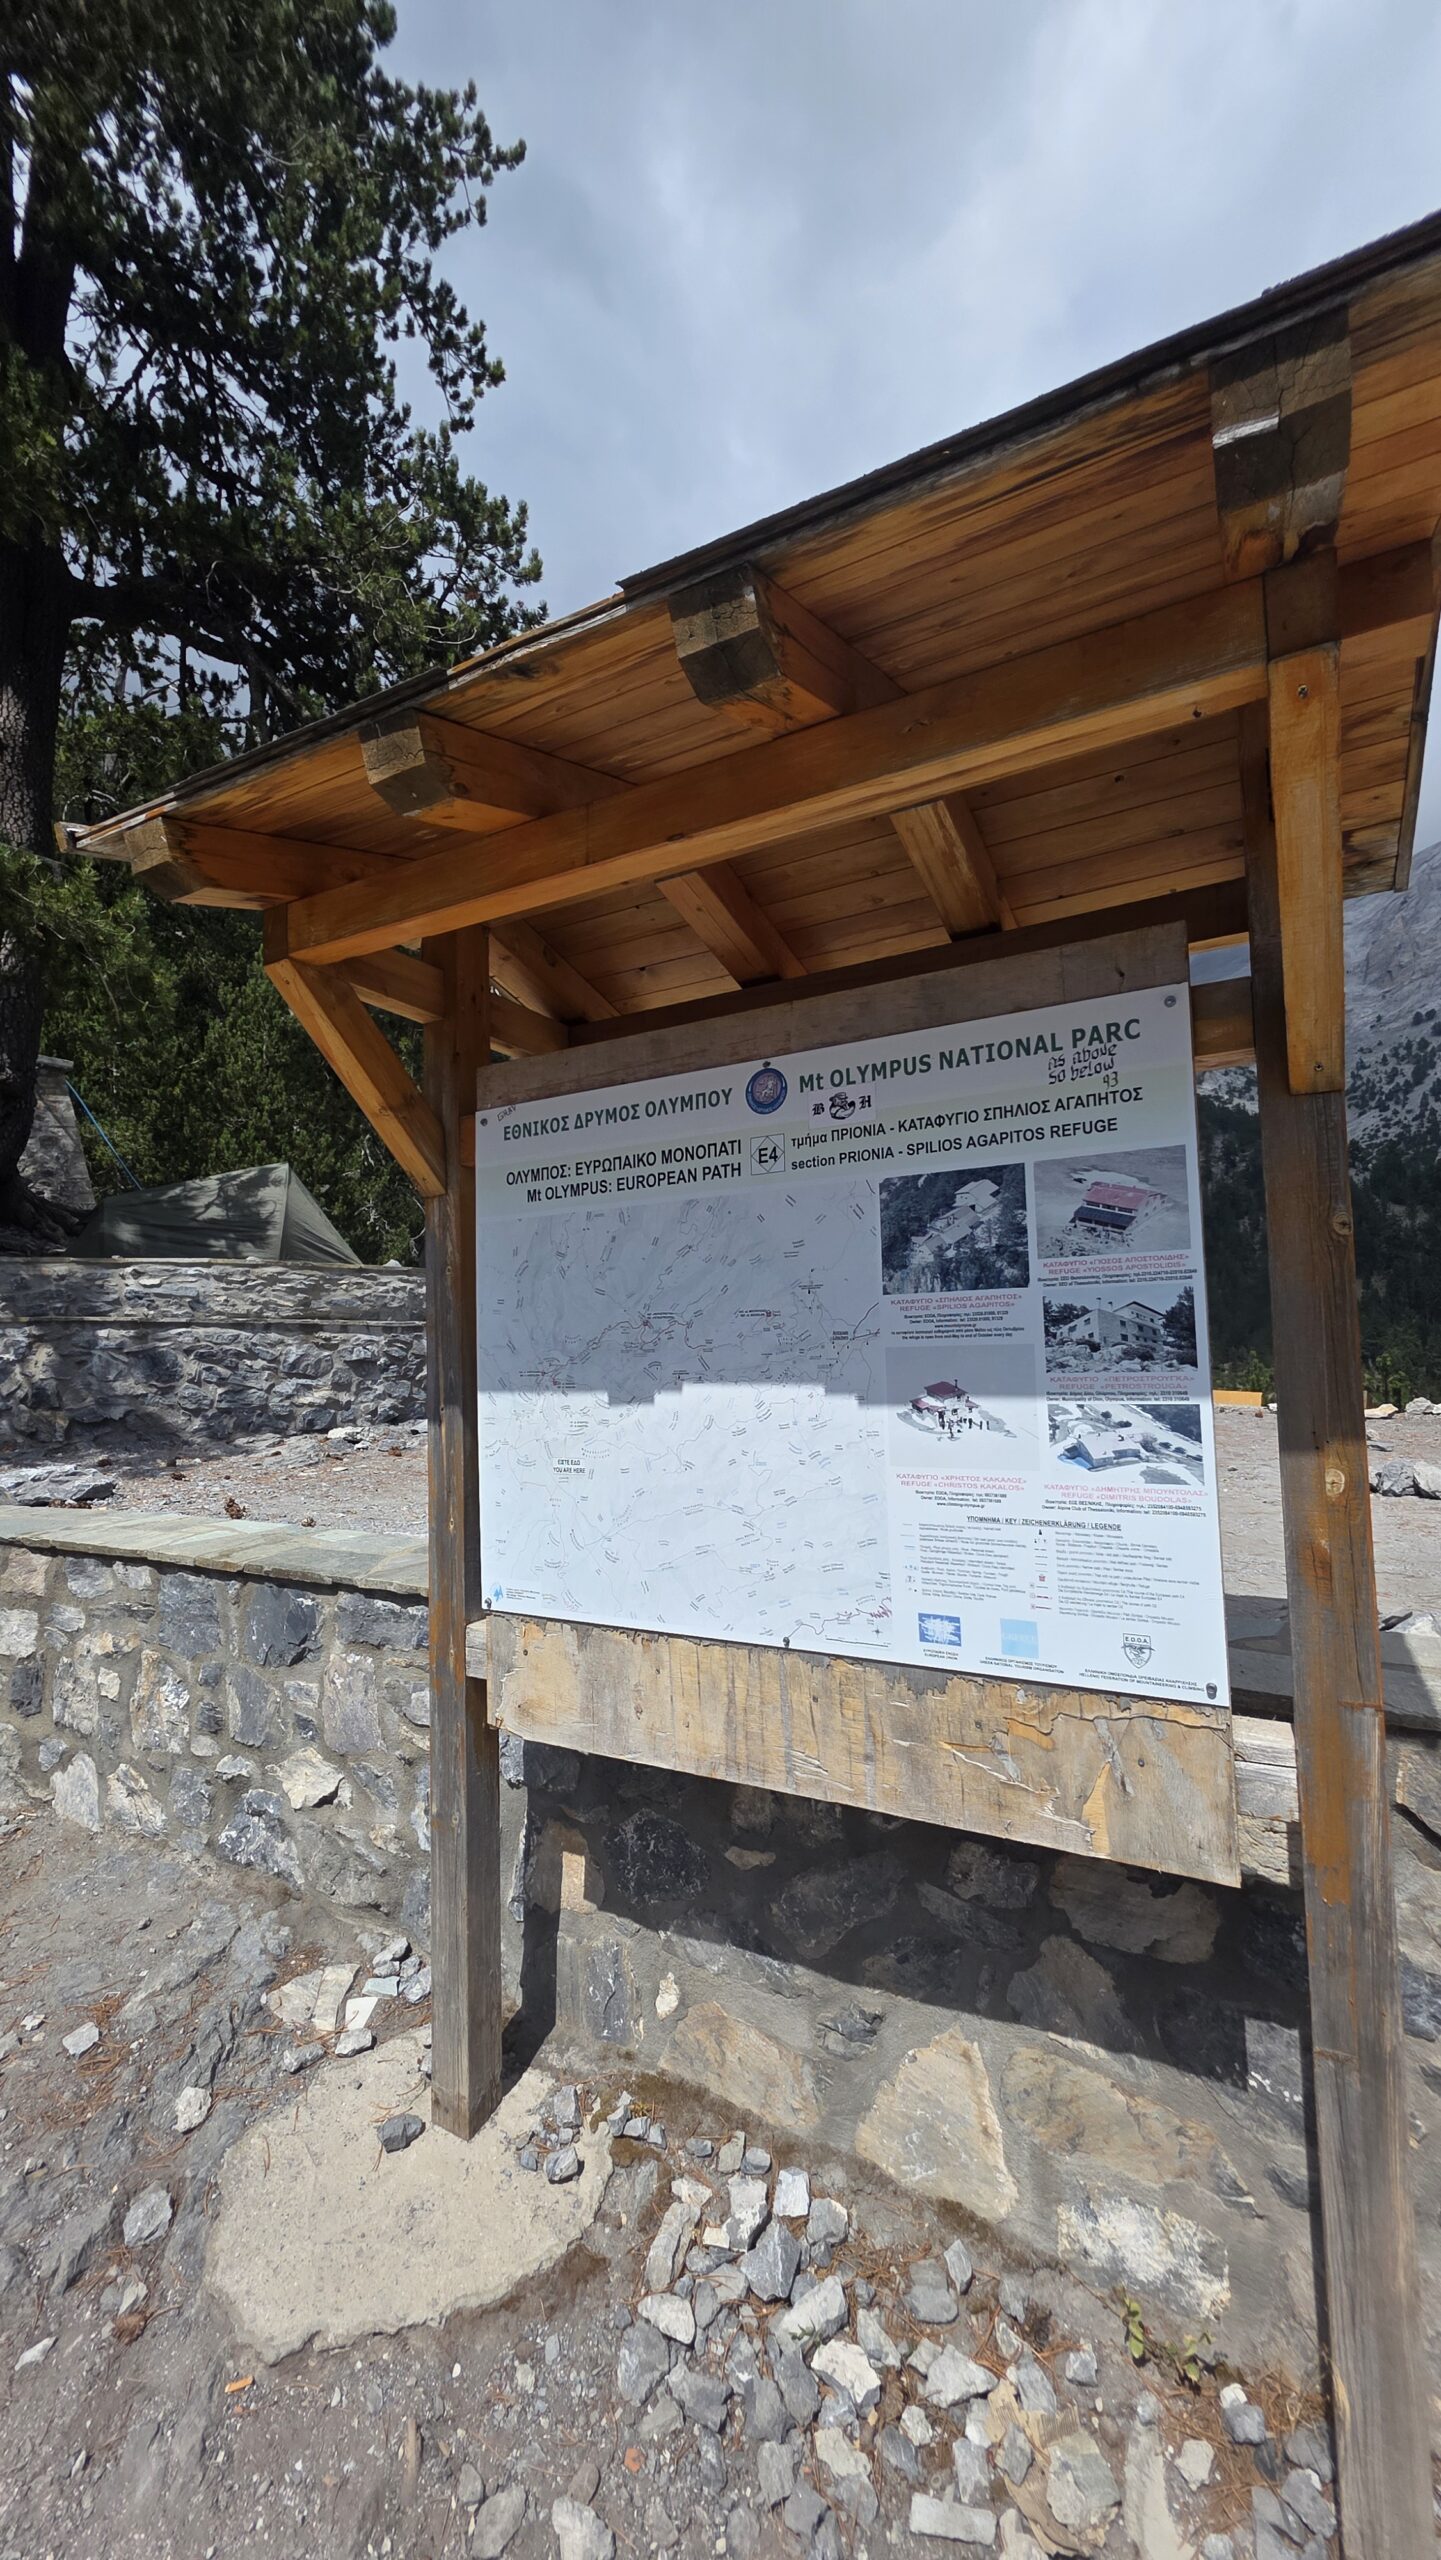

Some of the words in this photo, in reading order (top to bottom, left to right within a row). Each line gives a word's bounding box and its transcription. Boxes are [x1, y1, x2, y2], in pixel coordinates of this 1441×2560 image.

[800, 1074, 824, 1093] Mt
[830, 1054, 931, 1088] OLYMPUS
[939, 1032, 1063, 1070] NATIONAL
[1072, 1018, 1141, 1049] PARC
[1071, 1057, 1114, 1081] below
[503, 1115, 570, 1141] ΕΘΝΙΚΟΣ
[574, 1104, 641, 1129] ΔΡΥΜΟΣ
[645, 1088, 733, 1118] ΟΛΥΜΠΟΥ
[791, 1132, 827, 1149] τμήμα
[831, 1123, 886, 1142] ΠΡΙΟΝΙΑ
[898, 1110, 979, 1133] ΚΑΤΑΦΥΓΙΟ
[983, 1100, 1050, 1121] ΣΠΗΛΙΟΣ
[1054, 1087, 1143, 1112] ΑΓΑΠΗΤΟΣ
[758, 1146, 779, 1164] E4
[791, 1155, 835, 1170] section
[839, 1147, 894, 1165] PRIONIA
[906, 1138, 962, 1156] SPILIOS
[966, 1127, 1045, 1149] AGAPITOS
[1050, 1117, 1118, 1139] REFUGE
[506, 1164, 571, 1186] ΟΛΥΜΠΟΣ:
[575, 1151, 657, 1176] ΕΥΡΩΠΑΙΚΟ
[661, 1139, 742, 1165] ΜΟΝΟΠΑΤΙ
[527, 1188, 542, 1203] Mt
[545, 1179, 612, 1201] OLYMPUS:
[617, 1168, 697, 1192] EUROPEAN
[702, 1162, 741, 1181] PATH
[1043, 1259, 1088, 1268] ΚΑΤΑΦΥΓΙΟ
[1048, 1267, 1081, 1275] REFUGE
[900, 1304, 931, 1312] REFUGE
[980, 1483, 1024, 1491] KAKALOS»
[1021, 1519, 1086, 1529] ZEICHENERKLÄRUNG
[1091, 1523, 1122, 1531] LEGENDE
